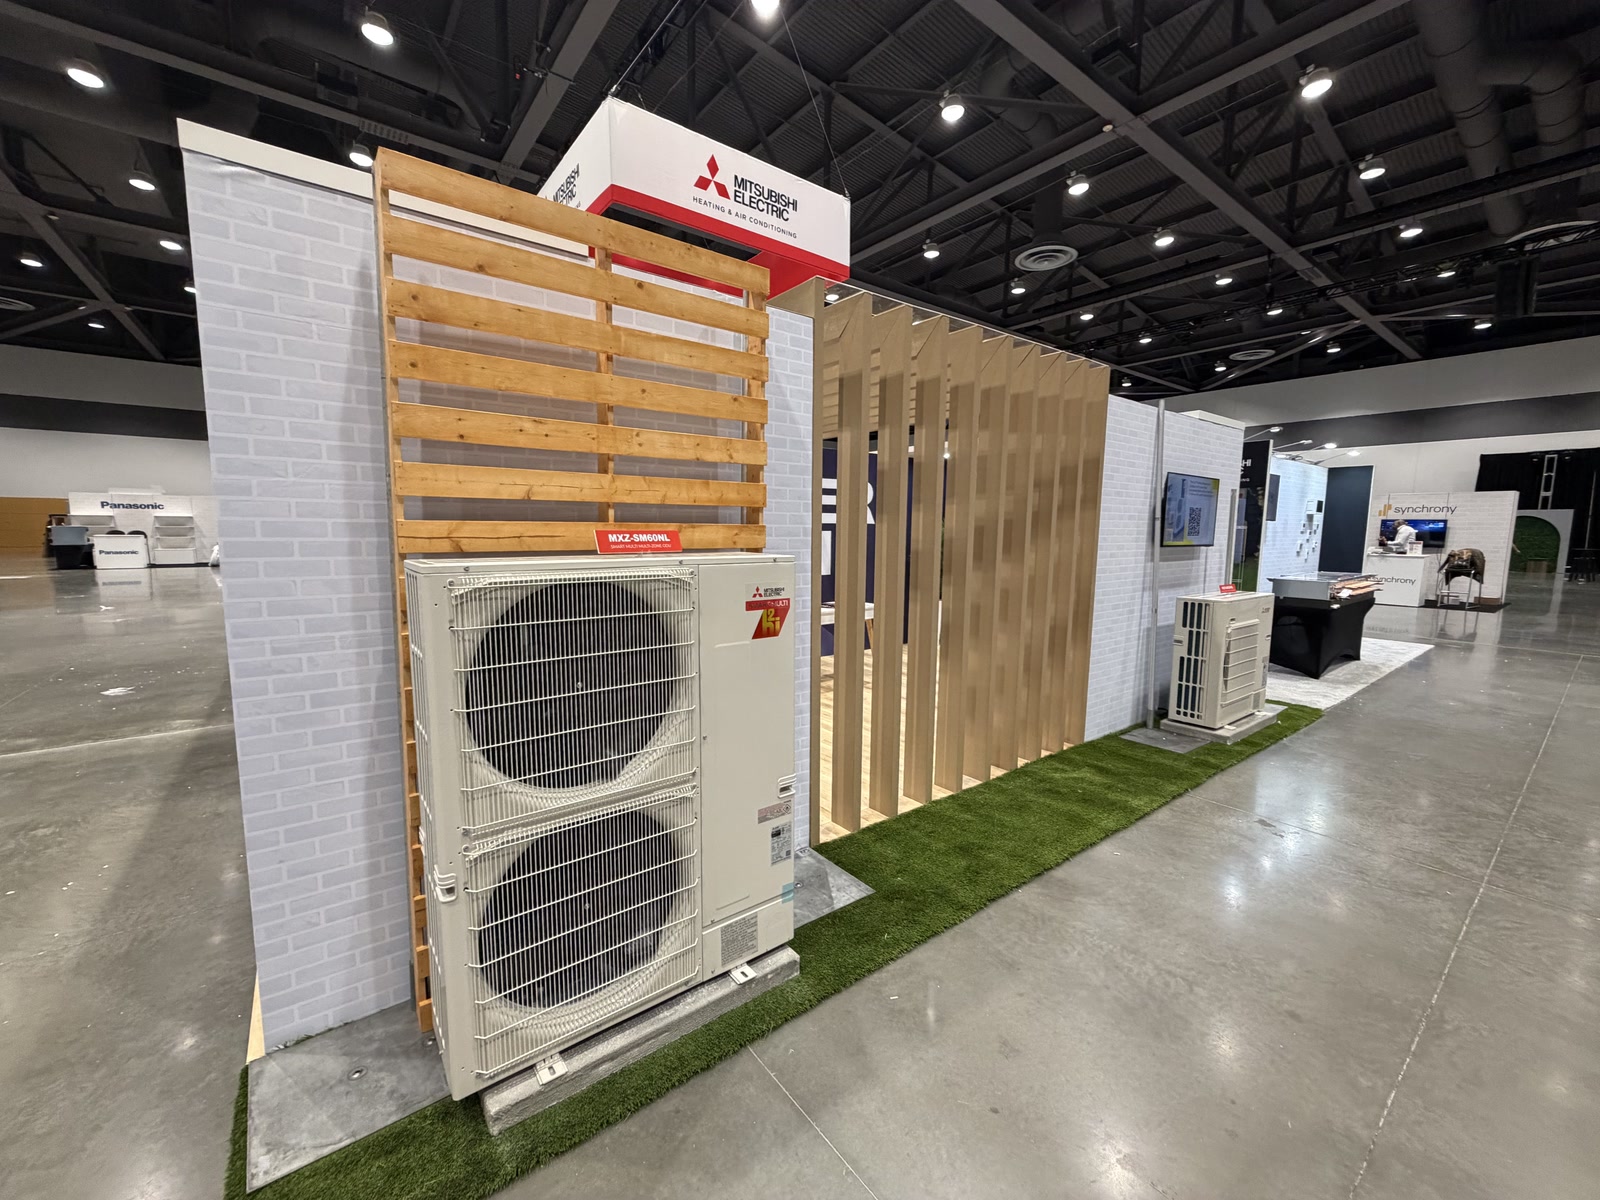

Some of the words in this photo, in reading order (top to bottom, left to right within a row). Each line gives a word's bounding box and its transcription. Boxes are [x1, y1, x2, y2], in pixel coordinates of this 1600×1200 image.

[734, 174, 798, 212] MITSUBISHI
[734, 189, 790, 222] ELECTRIC
[692, 196, 725, 213] HEATING
[735, 212, 747, 221] AIR
[749, 216, 797, 239] CONDITIONING
[100, 501, 165, 510] Panasonic
[1394, 504, 1457, 515] synchrony
[608, 533, 671, 542] MXZ-SM60NL
